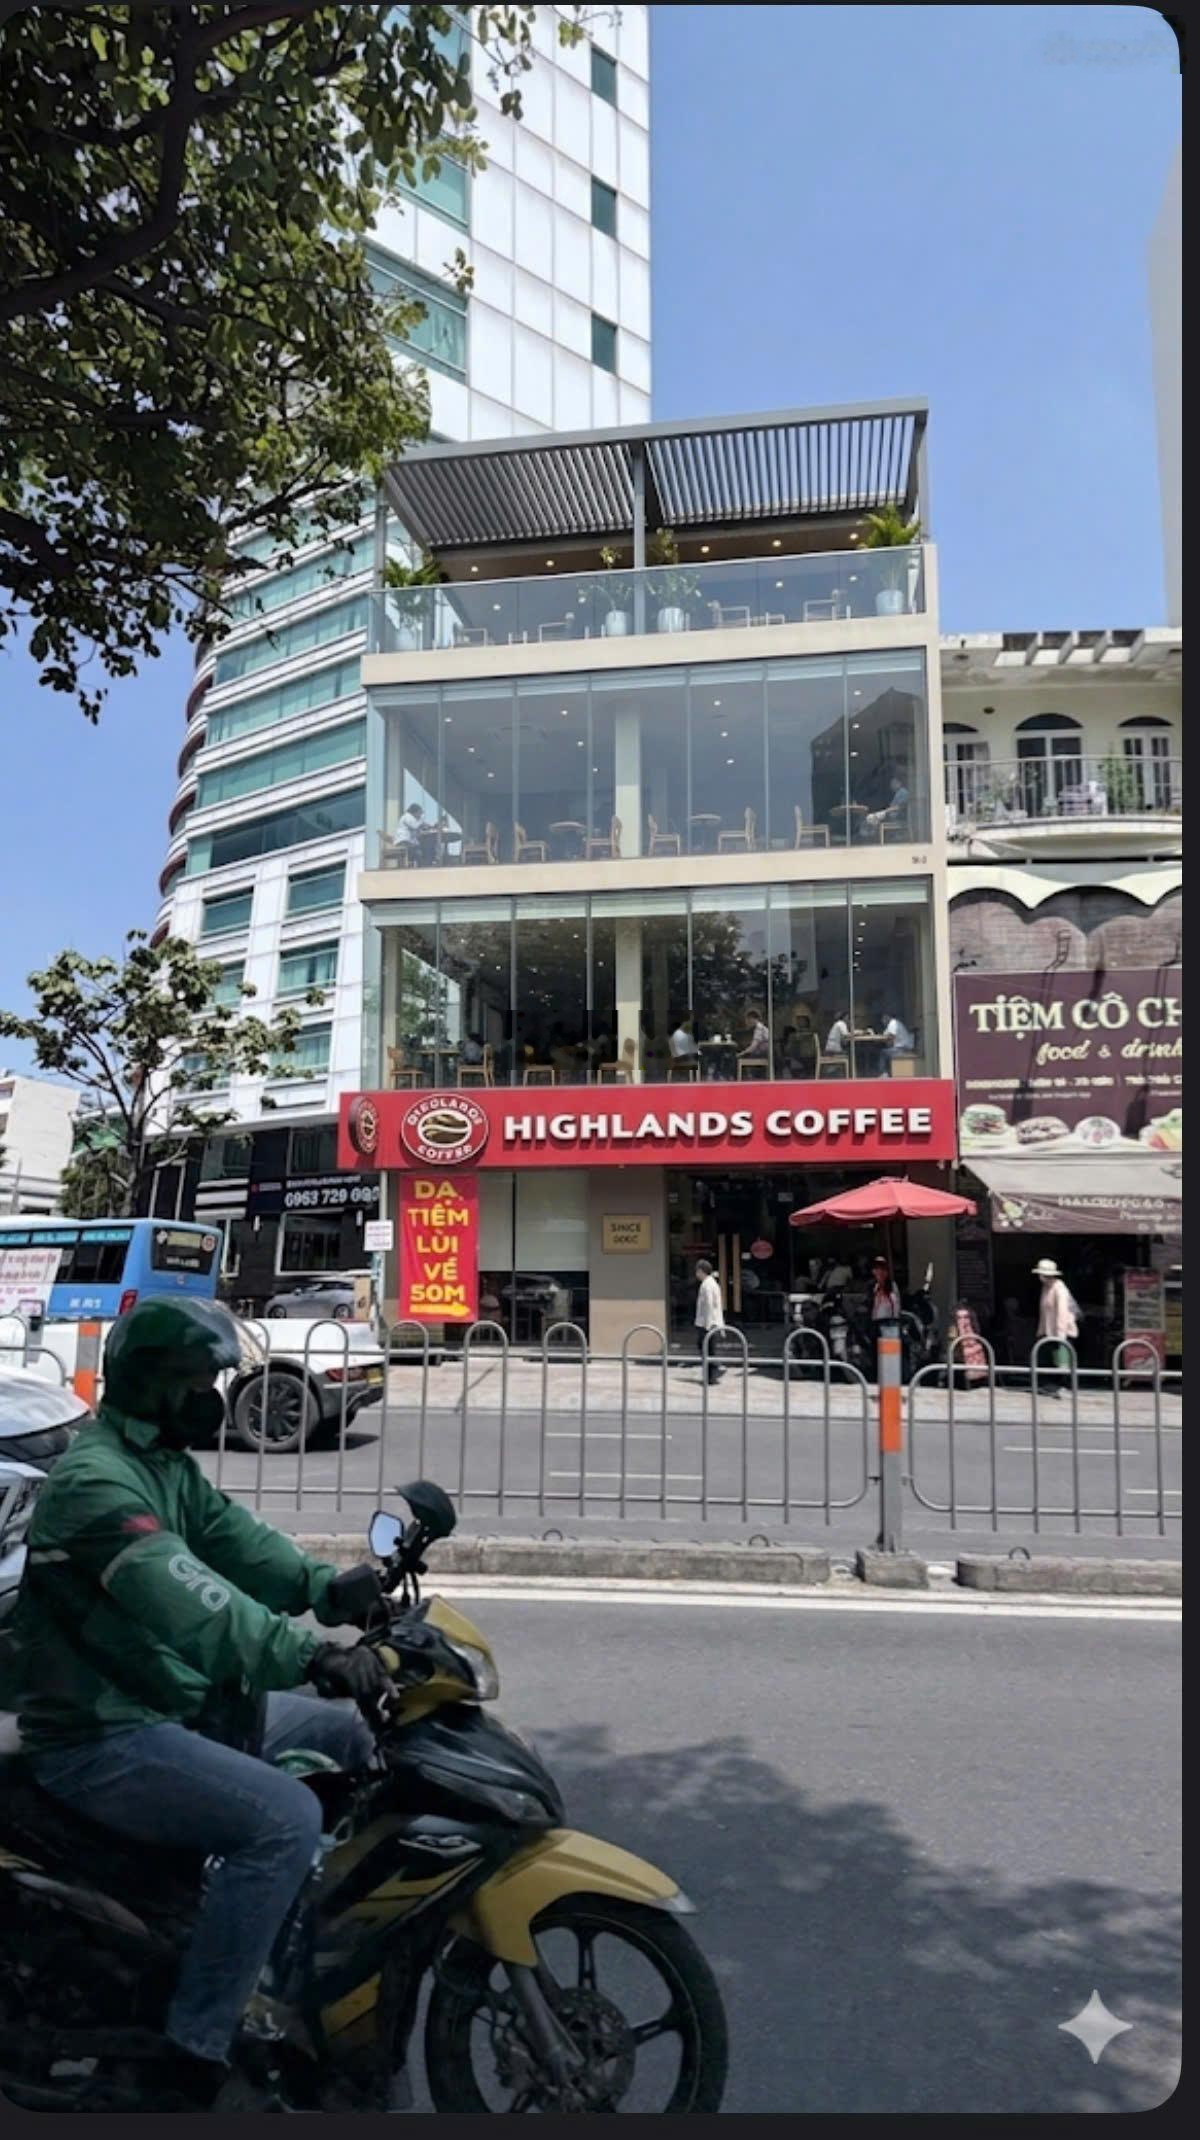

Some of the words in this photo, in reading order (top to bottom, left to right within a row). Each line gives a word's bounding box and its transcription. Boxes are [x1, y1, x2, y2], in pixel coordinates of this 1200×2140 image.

[1072, 991, 1130, 1030] CÔ
[1036, 1039, 1092, 1066] food
[504, 1111, 753, 1141] HIGHLANDS
[766, 1107, 932, 1137] COFFEE
